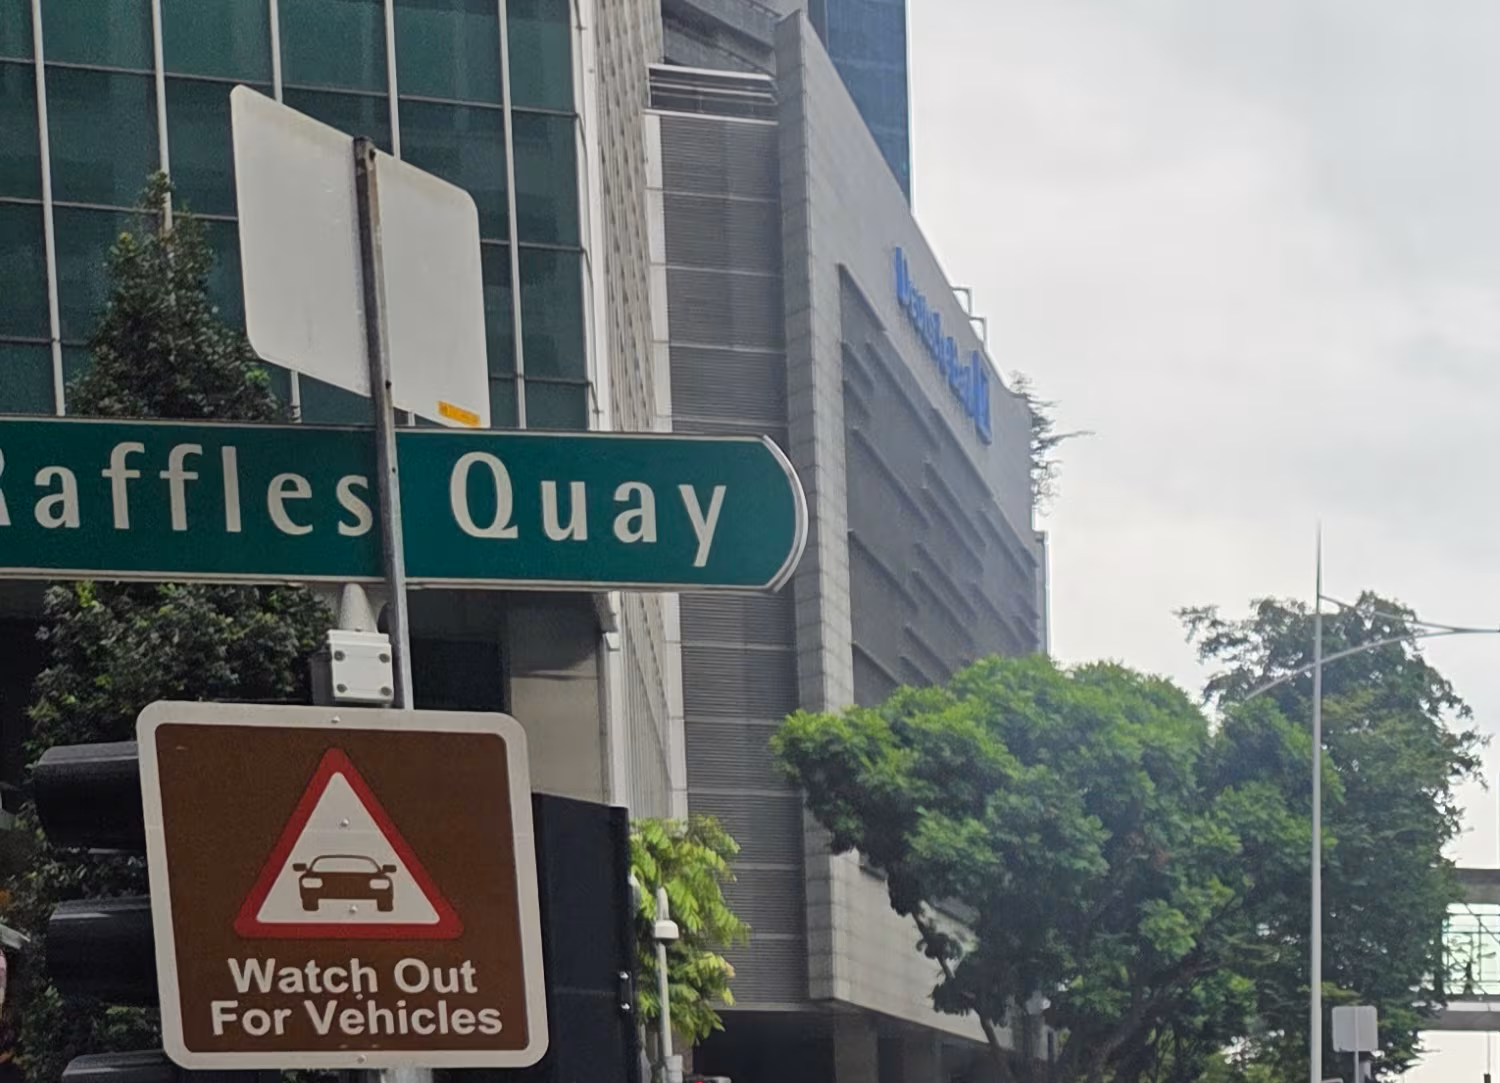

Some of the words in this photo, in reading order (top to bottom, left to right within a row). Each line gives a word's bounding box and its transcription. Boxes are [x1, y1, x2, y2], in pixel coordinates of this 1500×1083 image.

[0, 442, 374, 537] affles
[450, 451, 727, 568] Quay
[227, 957, 378, 994] Watch
[394, 957, 478, 994] Out
[210, 1000, 292, 1036] For
[304, 1000, 502, 1035] Vehicles
